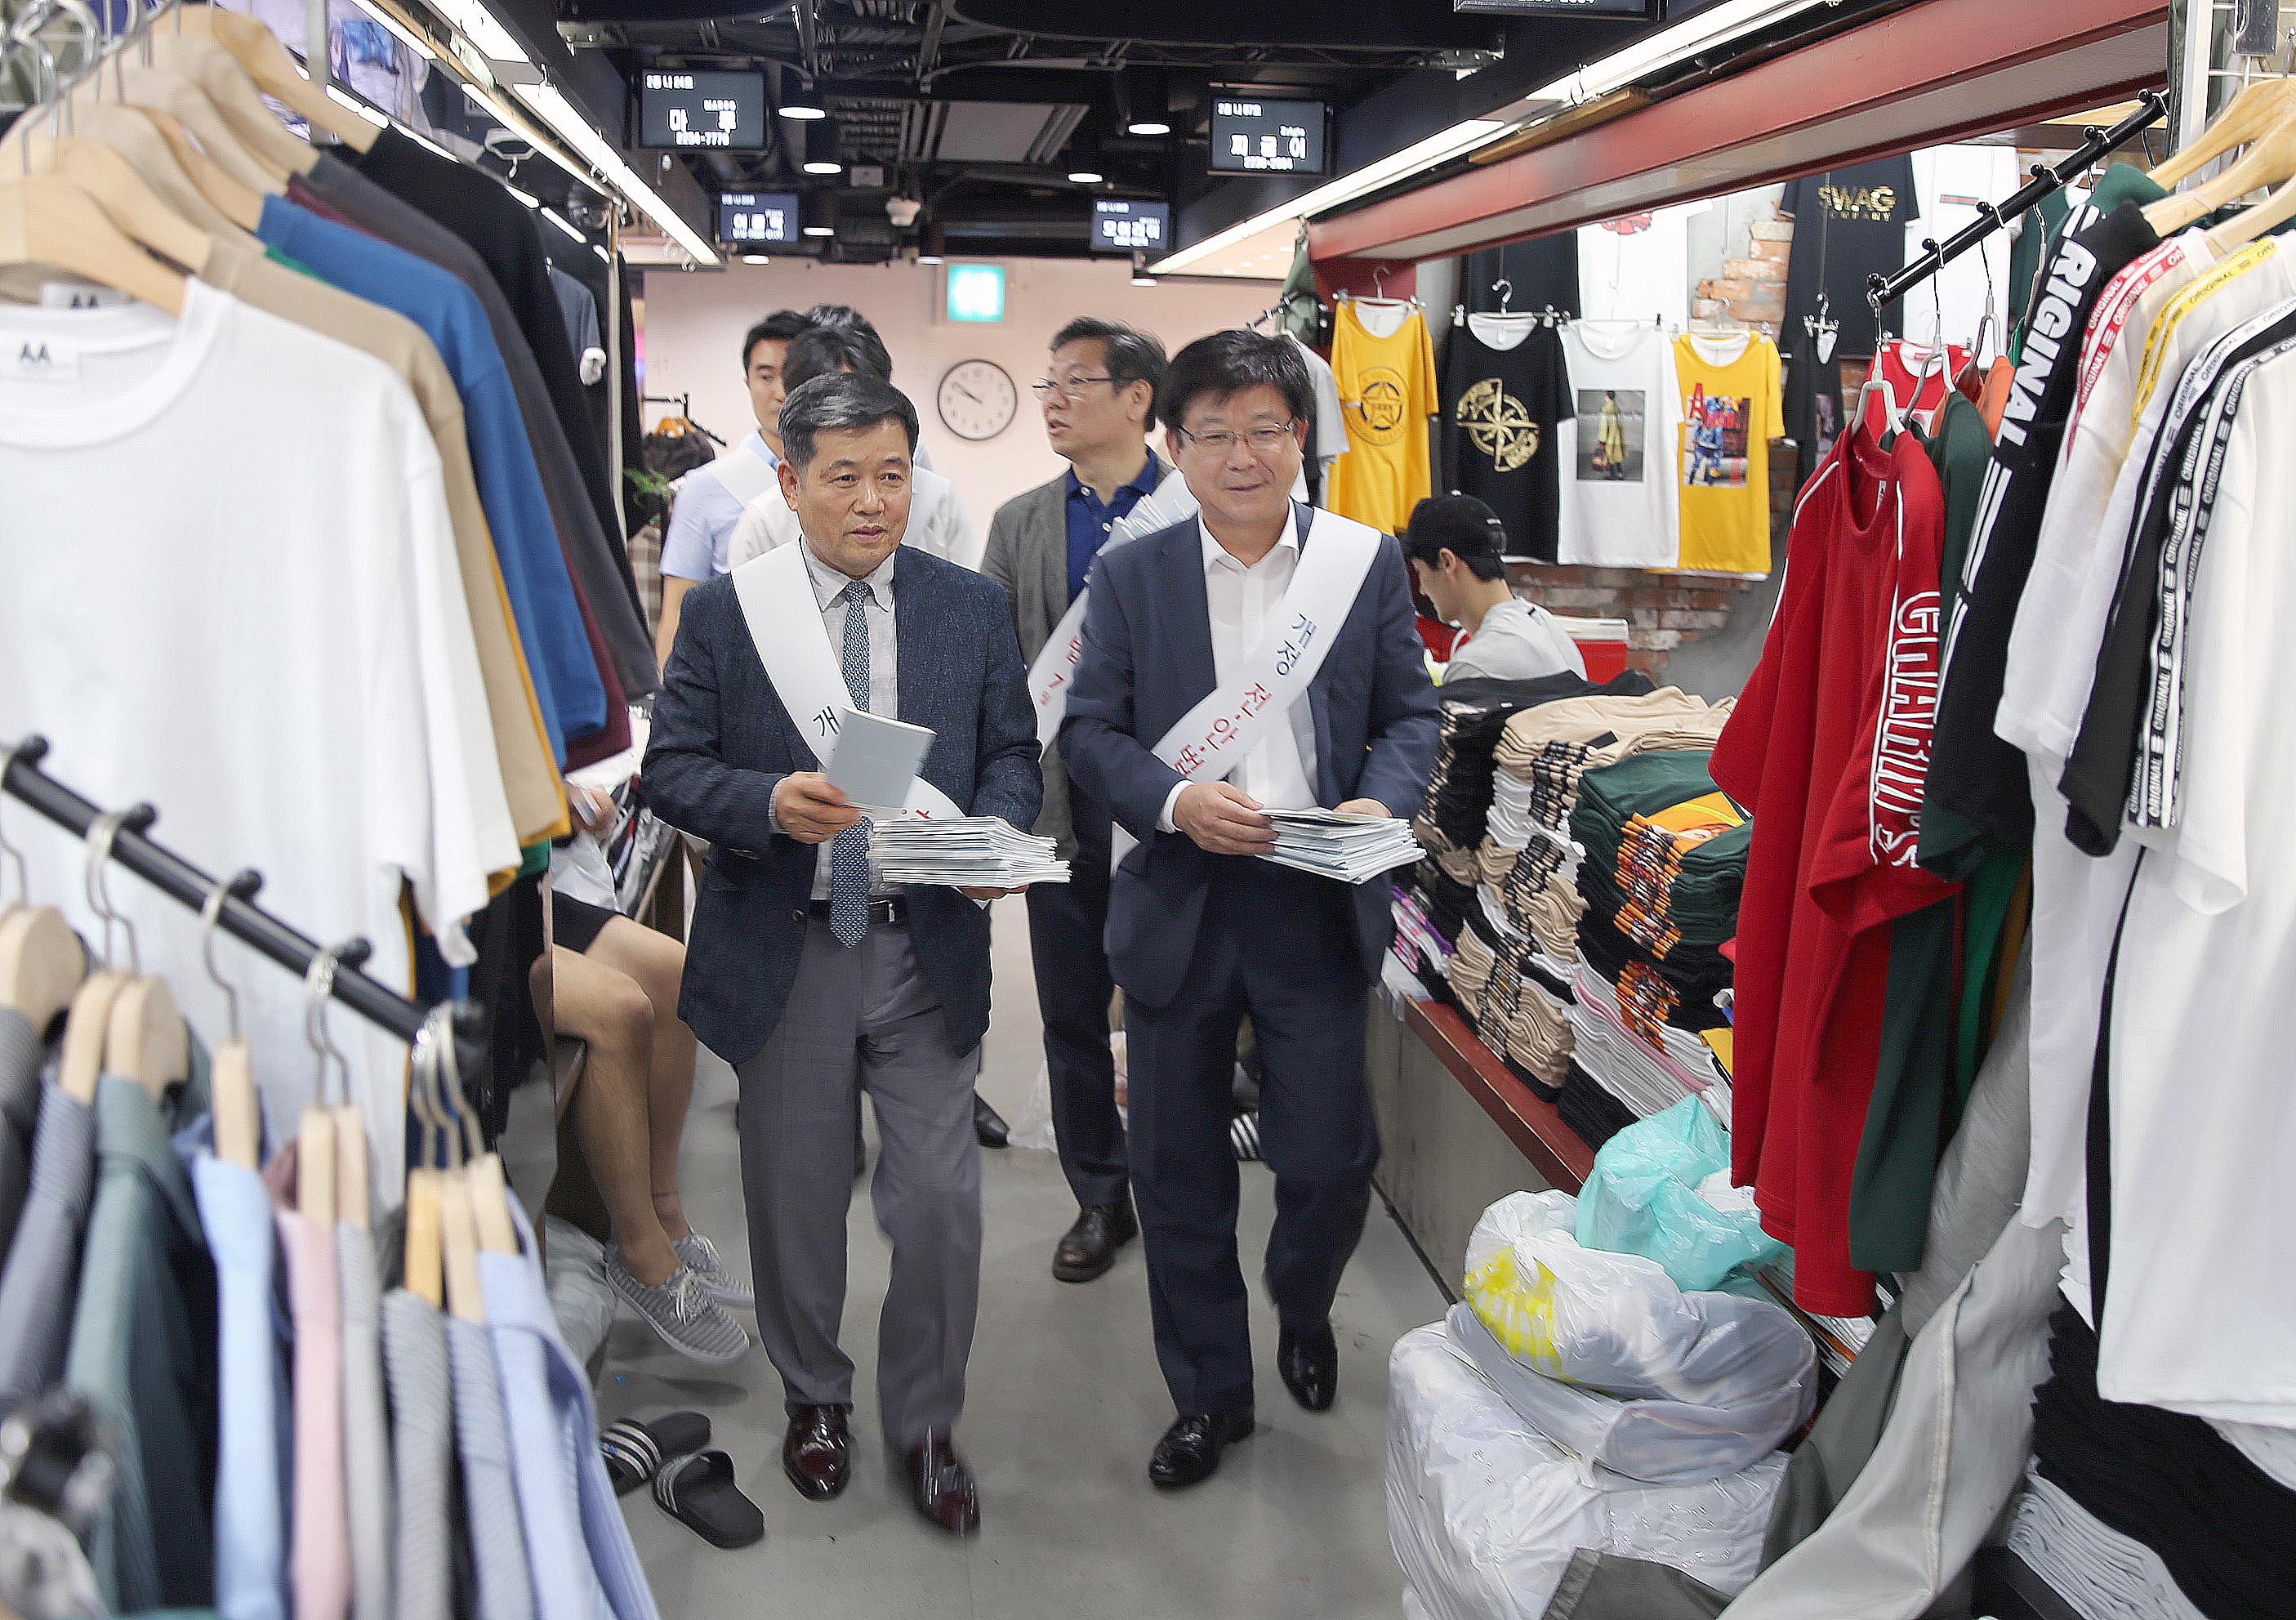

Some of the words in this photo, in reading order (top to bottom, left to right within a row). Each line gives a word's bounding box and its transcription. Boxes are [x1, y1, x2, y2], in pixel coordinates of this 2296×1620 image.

[2088, 279, 2124, 329] ORIGINAL
[1995, 239, 2097, 447] RIGINAL
[1275, 612, 1317, 676] 개정
